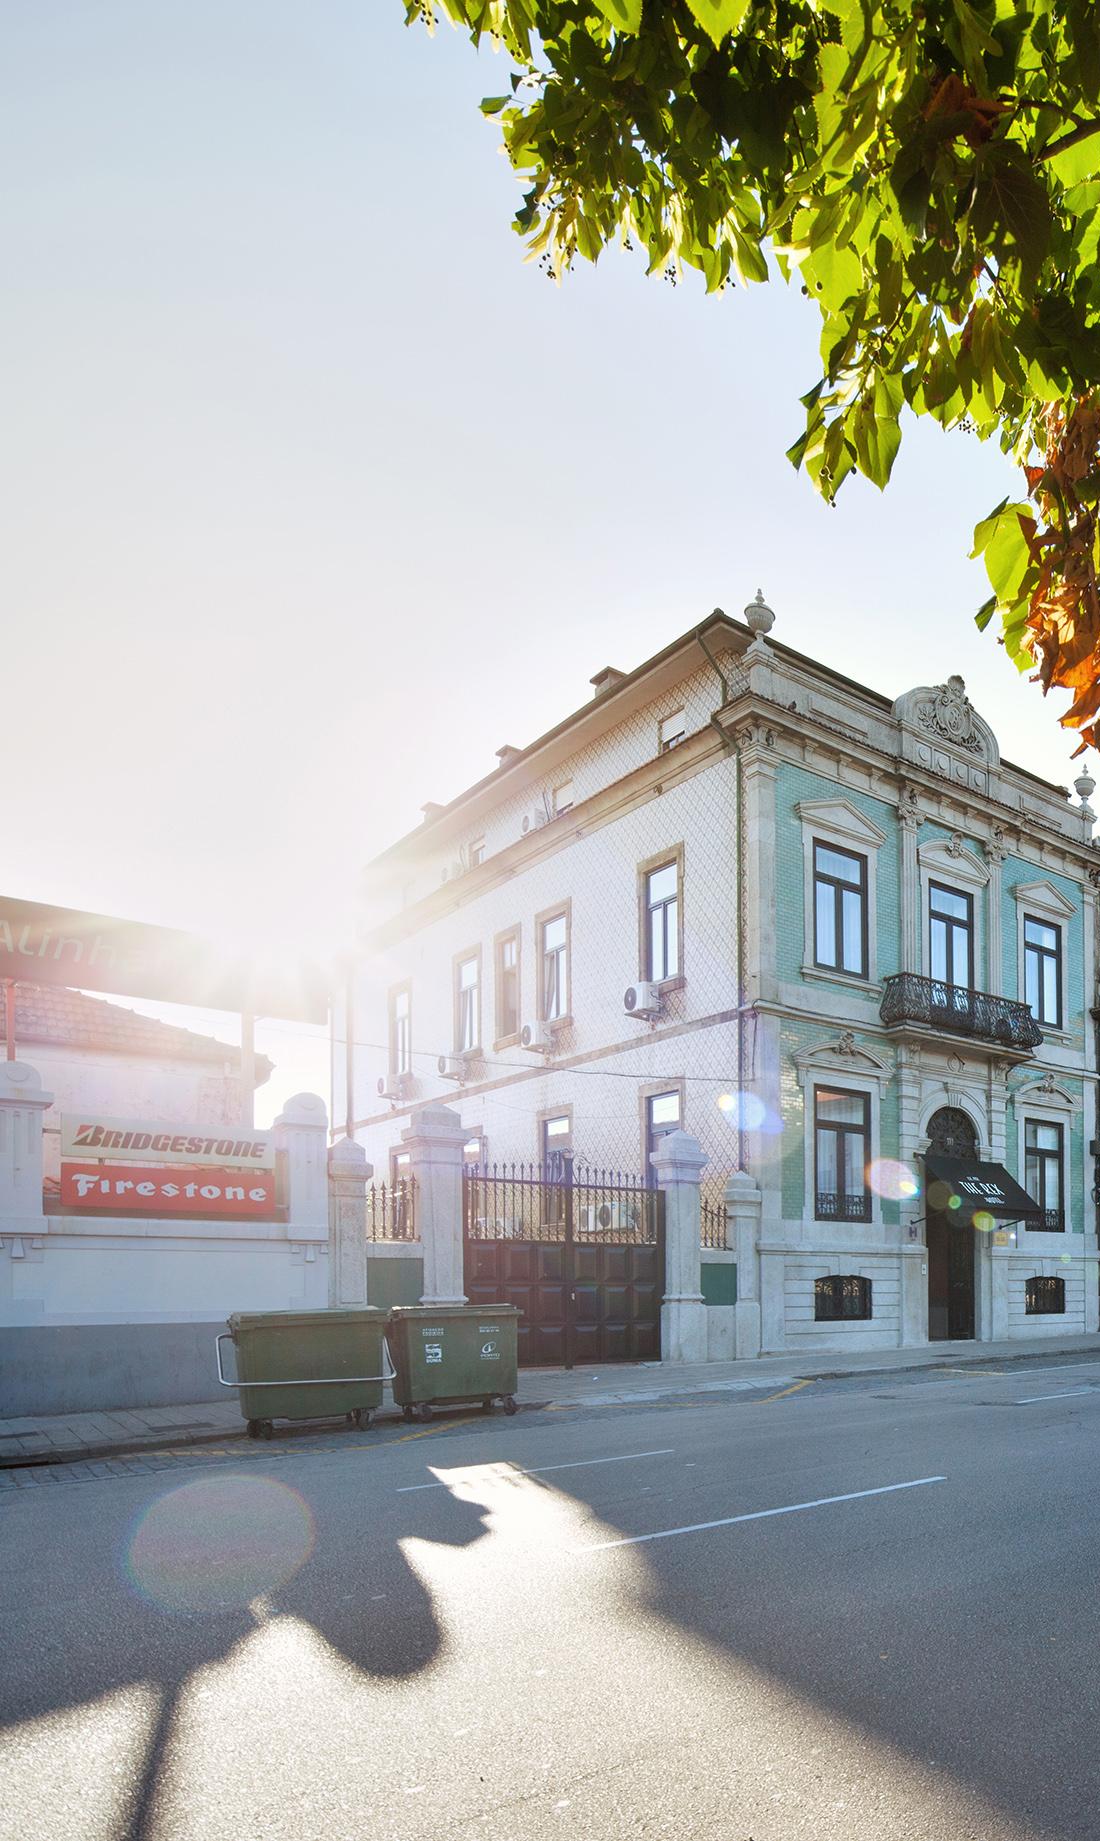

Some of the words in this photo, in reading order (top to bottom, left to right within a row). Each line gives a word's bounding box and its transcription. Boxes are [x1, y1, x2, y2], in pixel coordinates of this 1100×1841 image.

[72, 1125, 267, 1159] BRIDGESTONE
[71, 1173, 267, 1202] Firestone
[959, 1181, 984, 1195] THE
[980, 1183, 1005, 1196] REX
